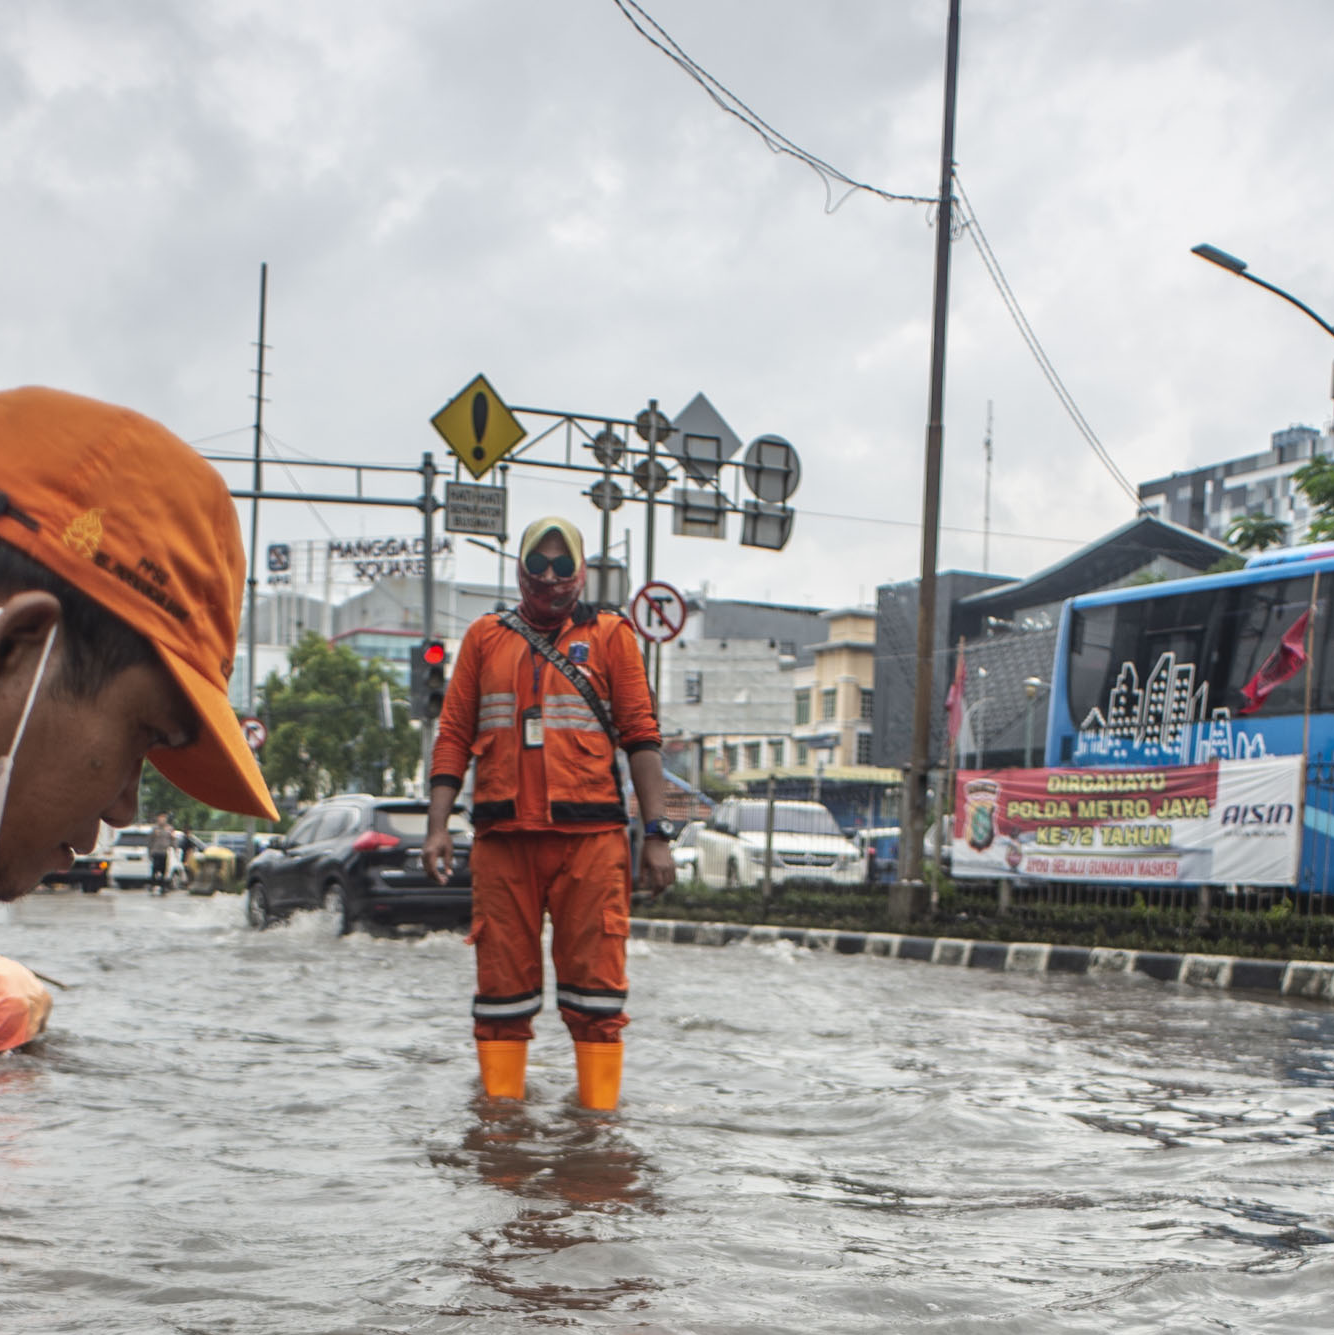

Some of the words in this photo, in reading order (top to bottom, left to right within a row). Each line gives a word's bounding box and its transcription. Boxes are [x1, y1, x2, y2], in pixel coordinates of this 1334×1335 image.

[328, 538, 411, 558] MANGGA
[354, 559, 428, 582] SQUARE
[1046, 773, 1167, 794] DIRGAHAYU
[1007, 799, 1072, 820] POLDA
[1077, 799, 1151, 820] METRO
[1156, 796, 1210, 818] JAYA
[1036, 826, 1093, 846] KE-72
[1100, 824, 1172, 846] TAHUN
[1137, 859, 1180, 877] MASKER
